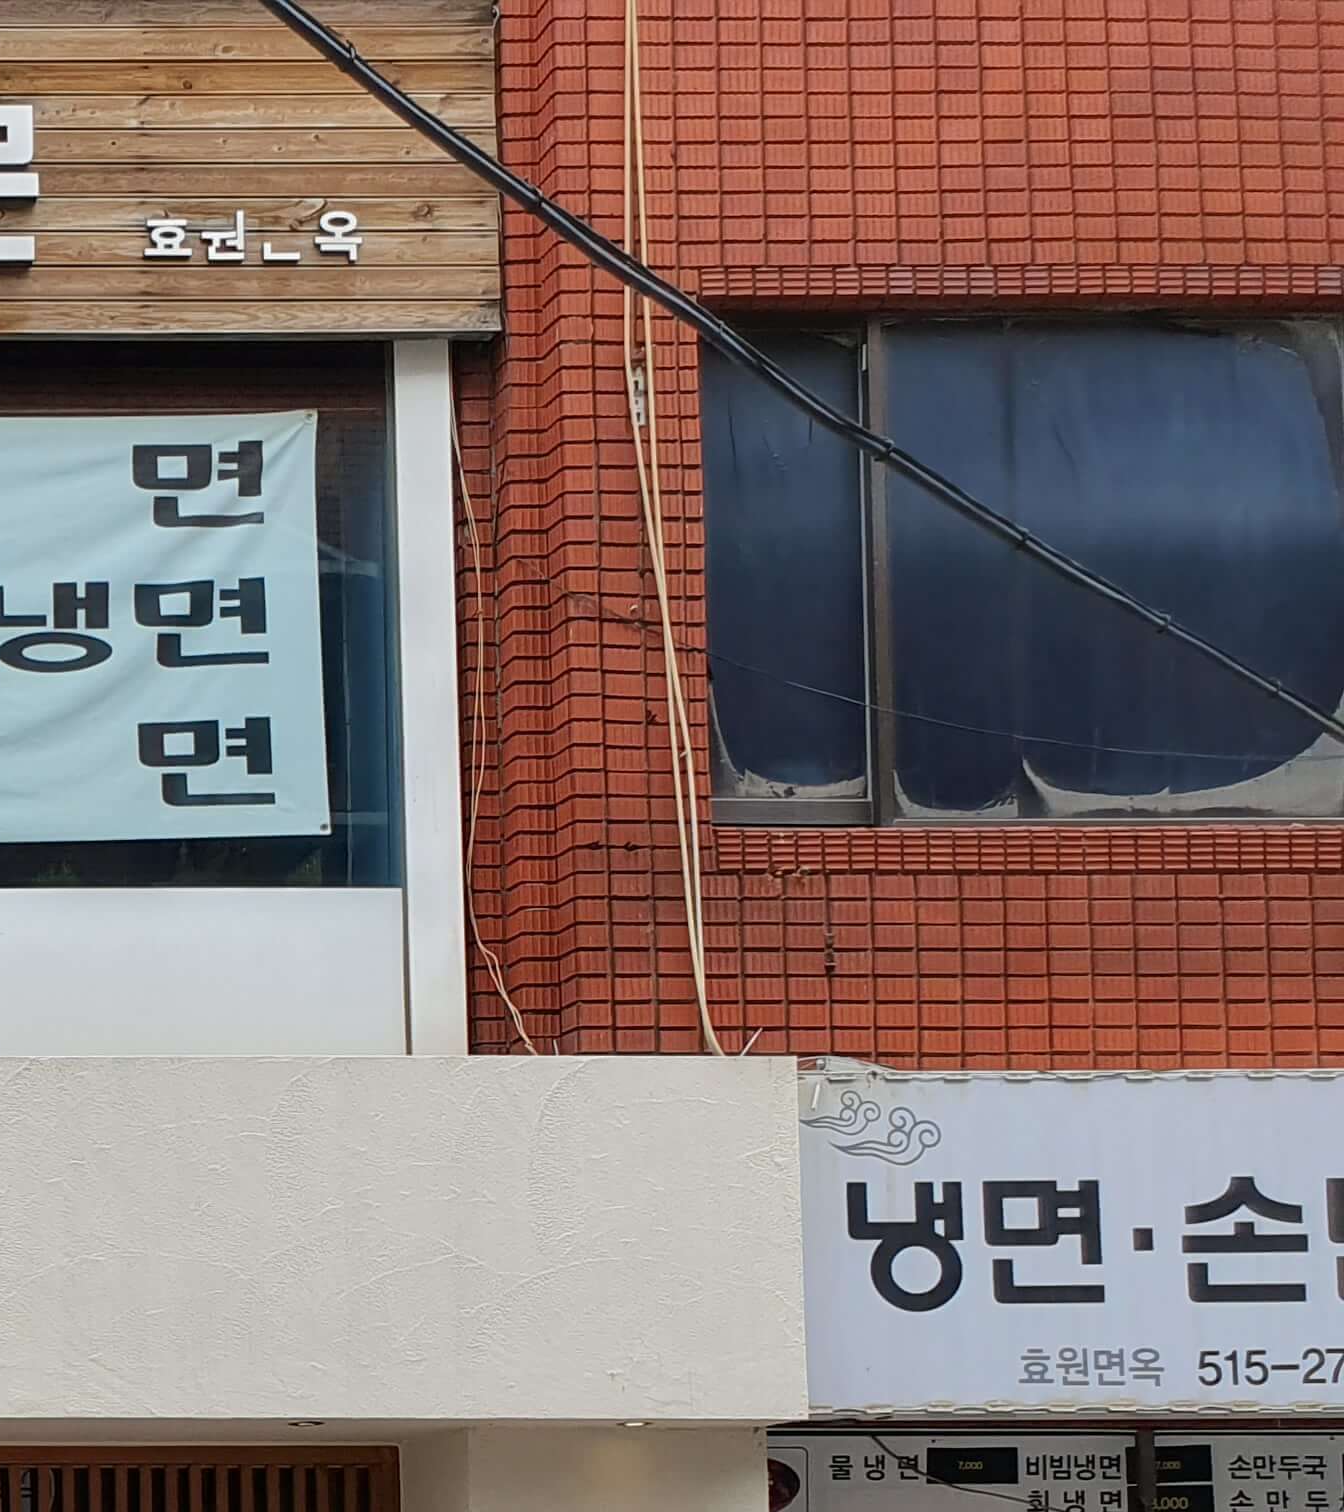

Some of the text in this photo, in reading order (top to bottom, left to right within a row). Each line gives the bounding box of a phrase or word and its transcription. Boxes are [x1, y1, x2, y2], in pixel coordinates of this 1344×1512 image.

[845, 1175, 1344, 1313] 냉면·손
[1018, 1348, 1165, 1387] 효원면옥
[1025, 1454, 1123, 1481] 비빔냉면
[1227, 1454, 1328, 1481] 손만두국
